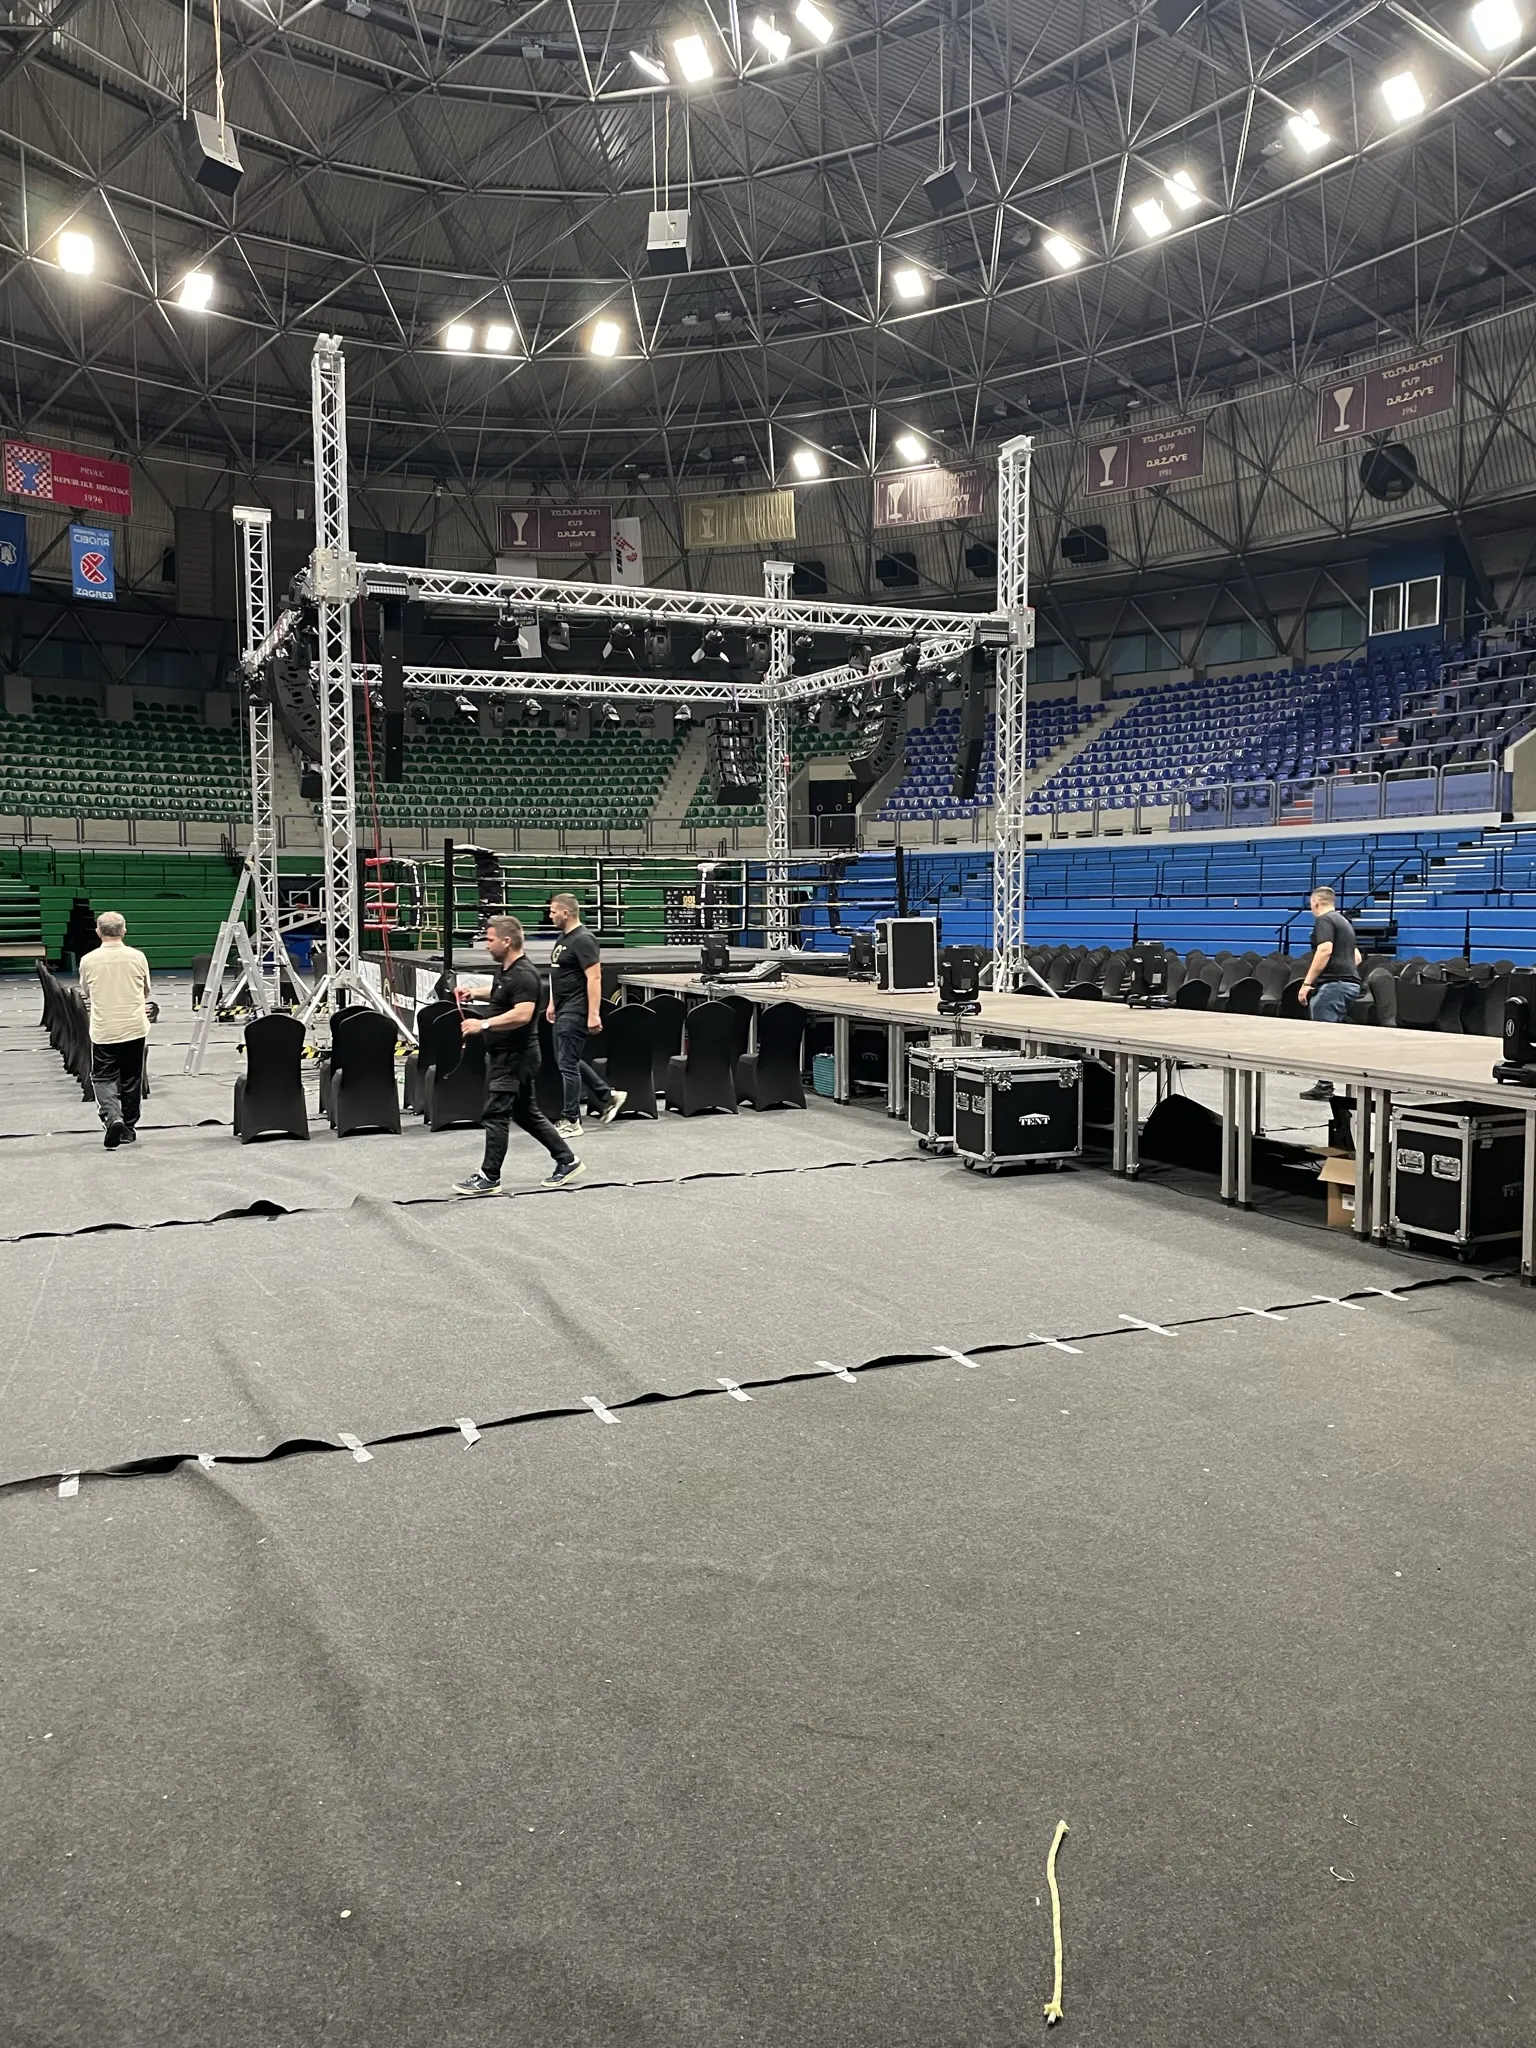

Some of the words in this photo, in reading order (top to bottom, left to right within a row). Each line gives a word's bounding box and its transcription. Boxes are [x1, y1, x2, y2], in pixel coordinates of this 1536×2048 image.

[1401, 376, 1421, 388] KUP
[1158, 443, 1176, 453] KUP
[79, 467, 105, 478] PRVAK
[53, 476, 95, 489] REPUBLIKE
[96, 484, 130, 496] HRVATSKE
[83, 493, 103, 504] 1996
[615, 548, 624, 575] HKS
[75, 587, 114, 600] ZAGREB
[1425, 1089, 1454, 1099] GUIL
[1018, 1116, 1051, 1126] TENT
